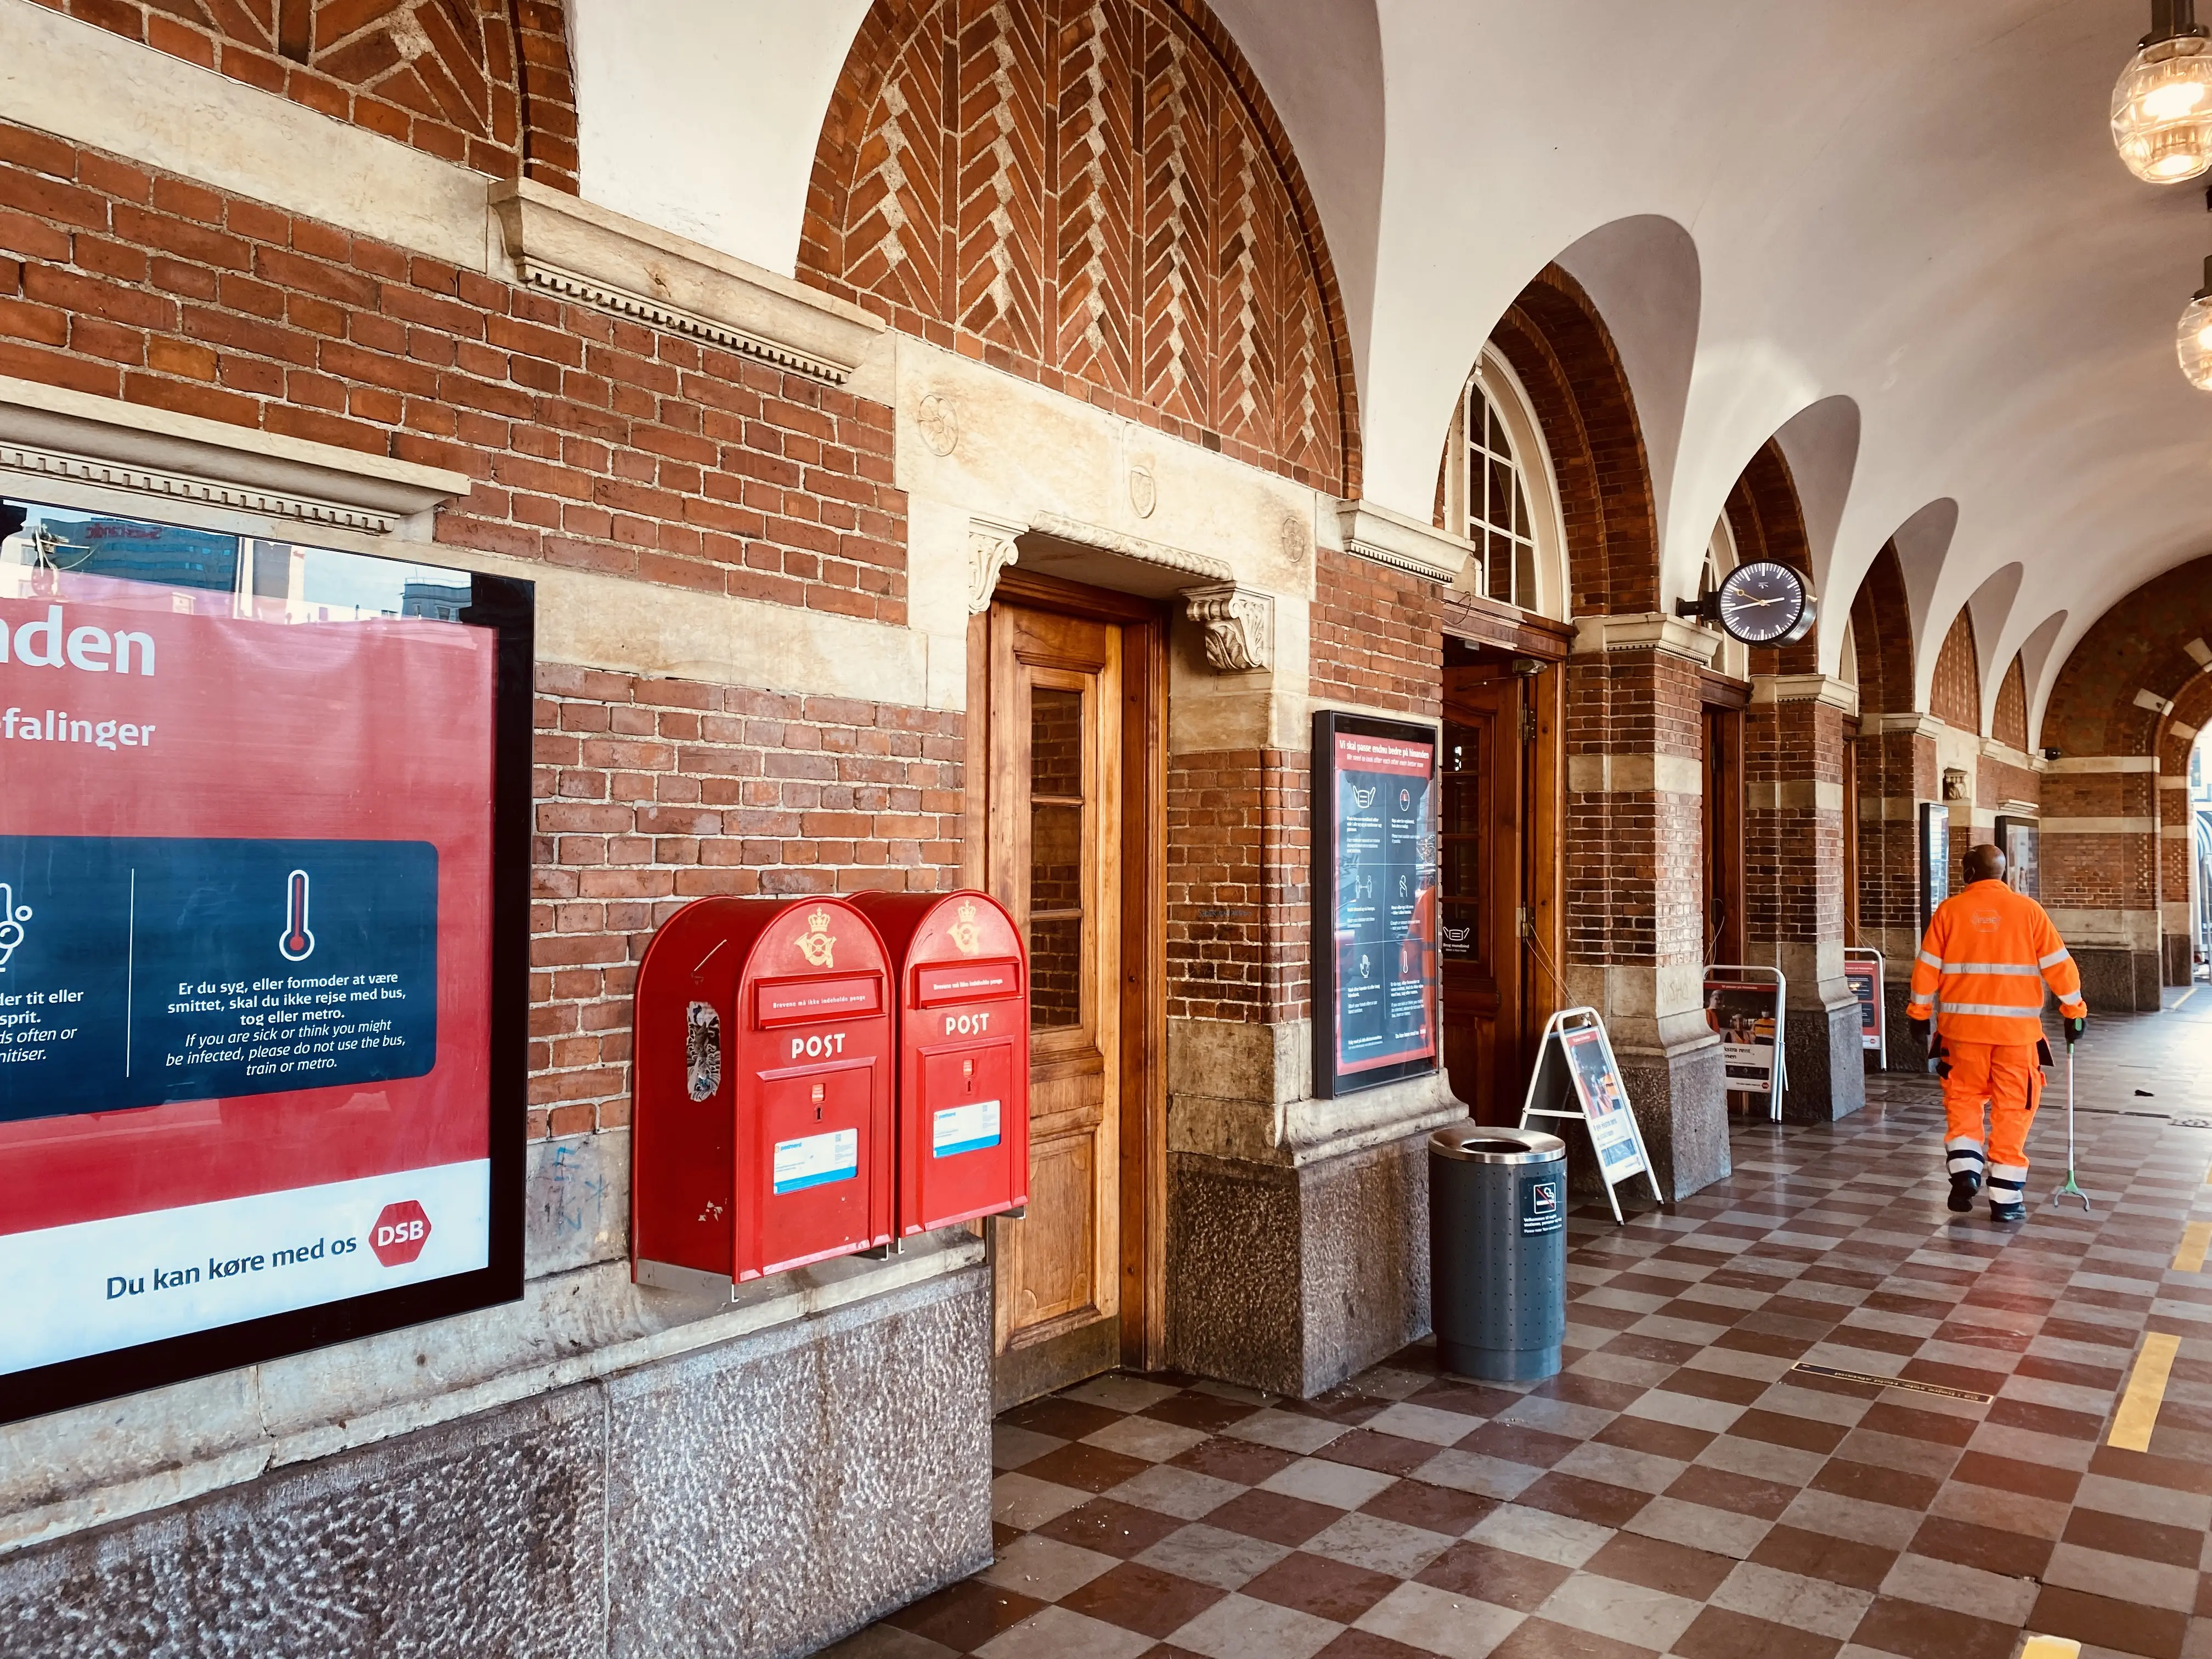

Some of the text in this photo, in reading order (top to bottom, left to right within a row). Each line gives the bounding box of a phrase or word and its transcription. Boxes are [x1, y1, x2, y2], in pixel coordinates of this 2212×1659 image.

[0, 605, 155, 676] den
[0, 708, 156, 751] falinger
[1339, 740, 1429, 759] Vi skal passe endnu bedre på hinanden
[179, 974, 398, 995] Er du syg, eller formoder at være
[26, 991, 45, 1005] tit
[48, 989, 84, 1003] eller
[167, 988, 406, 1013] smittet, skal du ikke rejse med bus,
[821, 996, 848, 1004] indeholde
[0, 1011, 41, 1028] sprit.
[240, 1009, 345, 1026] tog eller metro.
[946, 1013, 990, 1036] POST
[16, 1028, 57, 1043] often
[60, 1028, 78, 1040] or
[185, 1019, 392, 1049] If you are sick or think you might
[791, 1032, 846, 1059] POST
[166, 1035, 405, 1066] be infected, please do not use the bus,
[246, 1058, 337, 1075] train or metro.
[377, 1220, 425, 1248] DSB
[106, 1236, 357, 1301] Du kan køre med os
